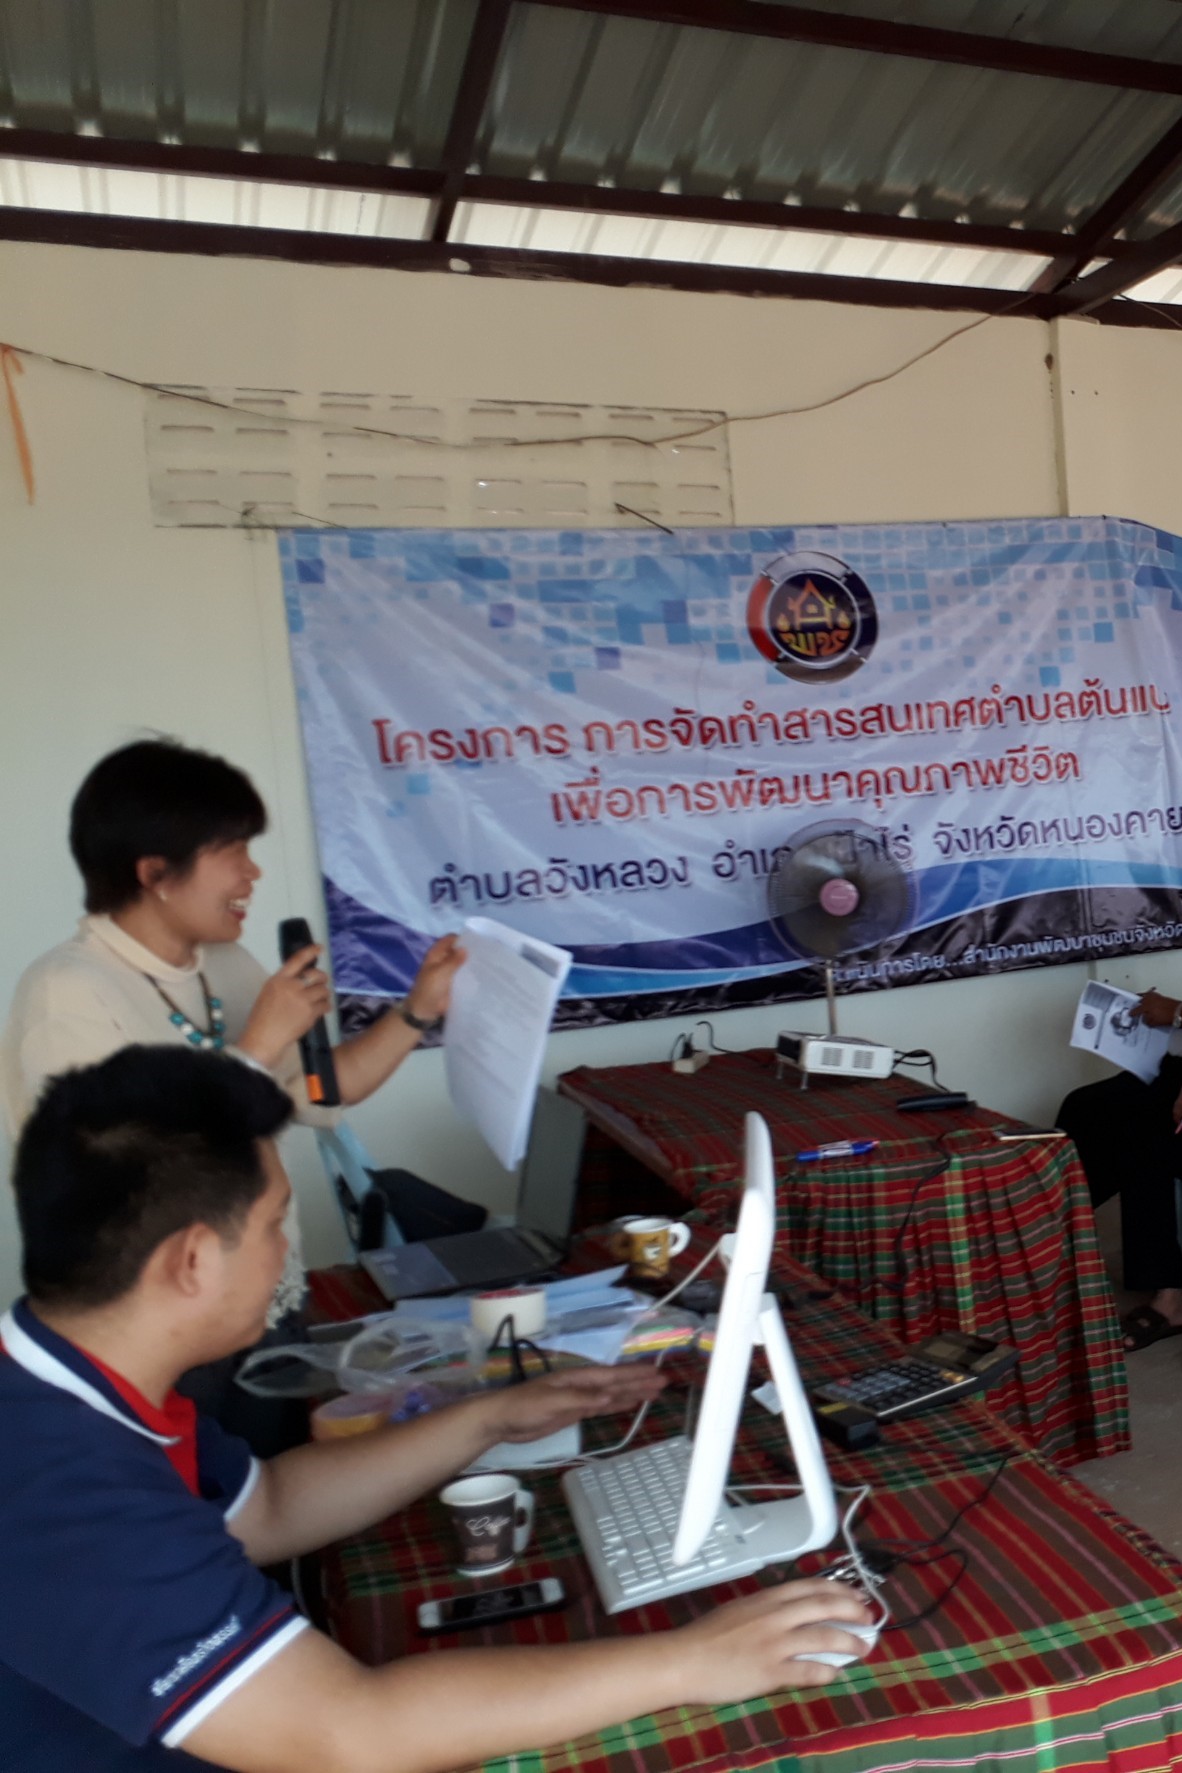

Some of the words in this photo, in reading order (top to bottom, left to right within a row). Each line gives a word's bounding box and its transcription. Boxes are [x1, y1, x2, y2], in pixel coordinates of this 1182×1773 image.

[371, 718, 571, 765] โครงการ
[550, 744, 1081, 824] เพื่อการพัฒนาคุณภาพชีวิต
[429, 855, 690, 905] ตำบลวังหลวง
